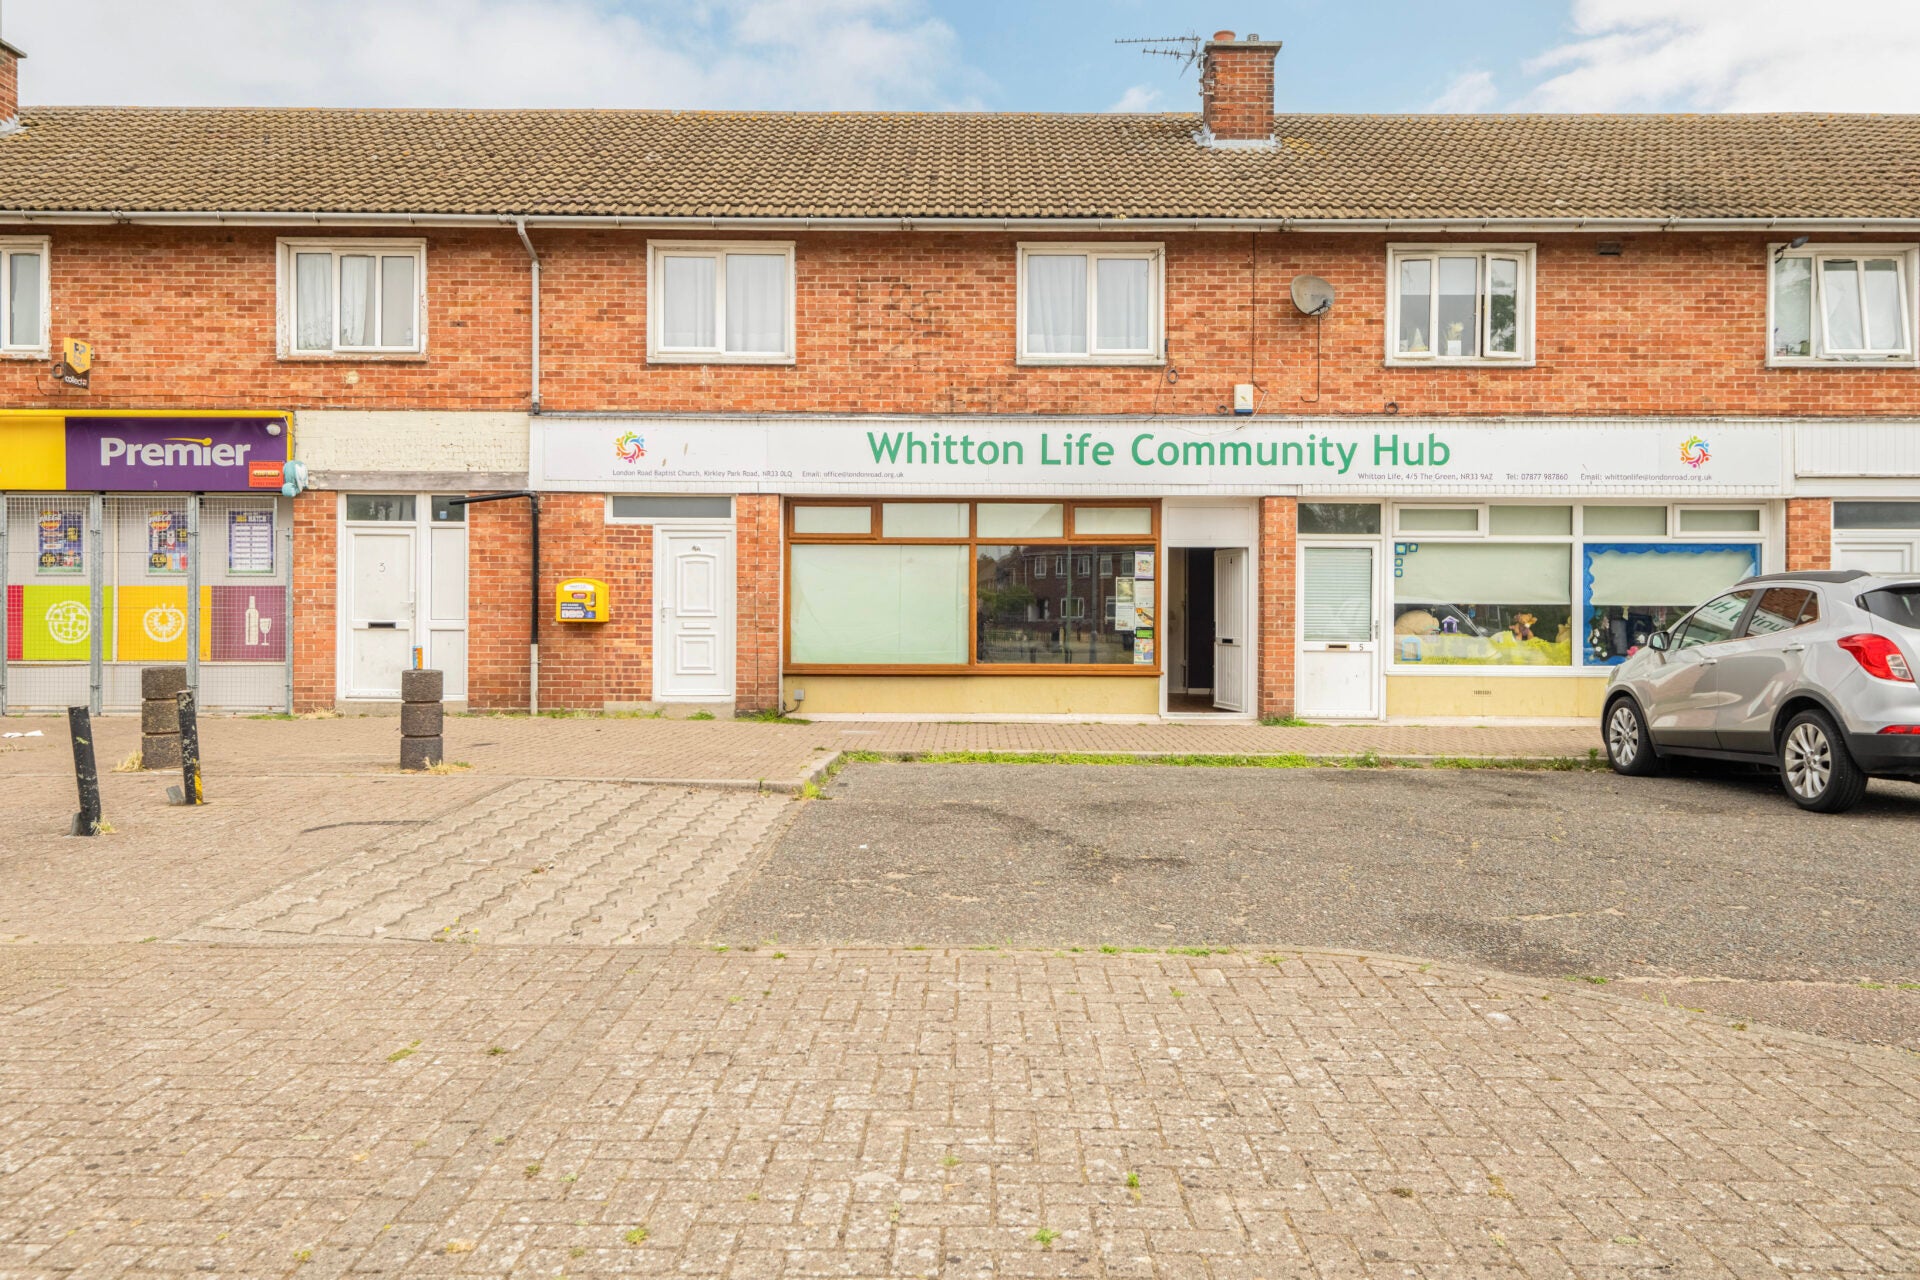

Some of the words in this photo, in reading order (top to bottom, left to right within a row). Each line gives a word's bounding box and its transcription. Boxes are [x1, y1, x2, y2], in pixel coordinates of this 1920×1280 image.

[100, 437, 251, 467] Premier
[866, 431, 1024, 465] Whitton
[1041, 432, 1115, 466] Life
[1131, 433, 1358, 475] Community
[1373, 432, 1451, 467] Hub
[654, 469, 676, 477] Baptist
[703, 470, 726, 478] Kirkley
[801, 470, 821, 478] Email:
[1357, 472, 1386, 480] Whitton
[1387, 472, 1404, 481] Life,
[1434, 473, 1459, 481] Green,
[1520, 473, 1542, 481] 07877
[1543, 473, 1569, 481] 987860
[1580, 473, 1602, 481] Email:
[378, 562, 386, 573] 3
[1359, 643, 1364, 651] 5
